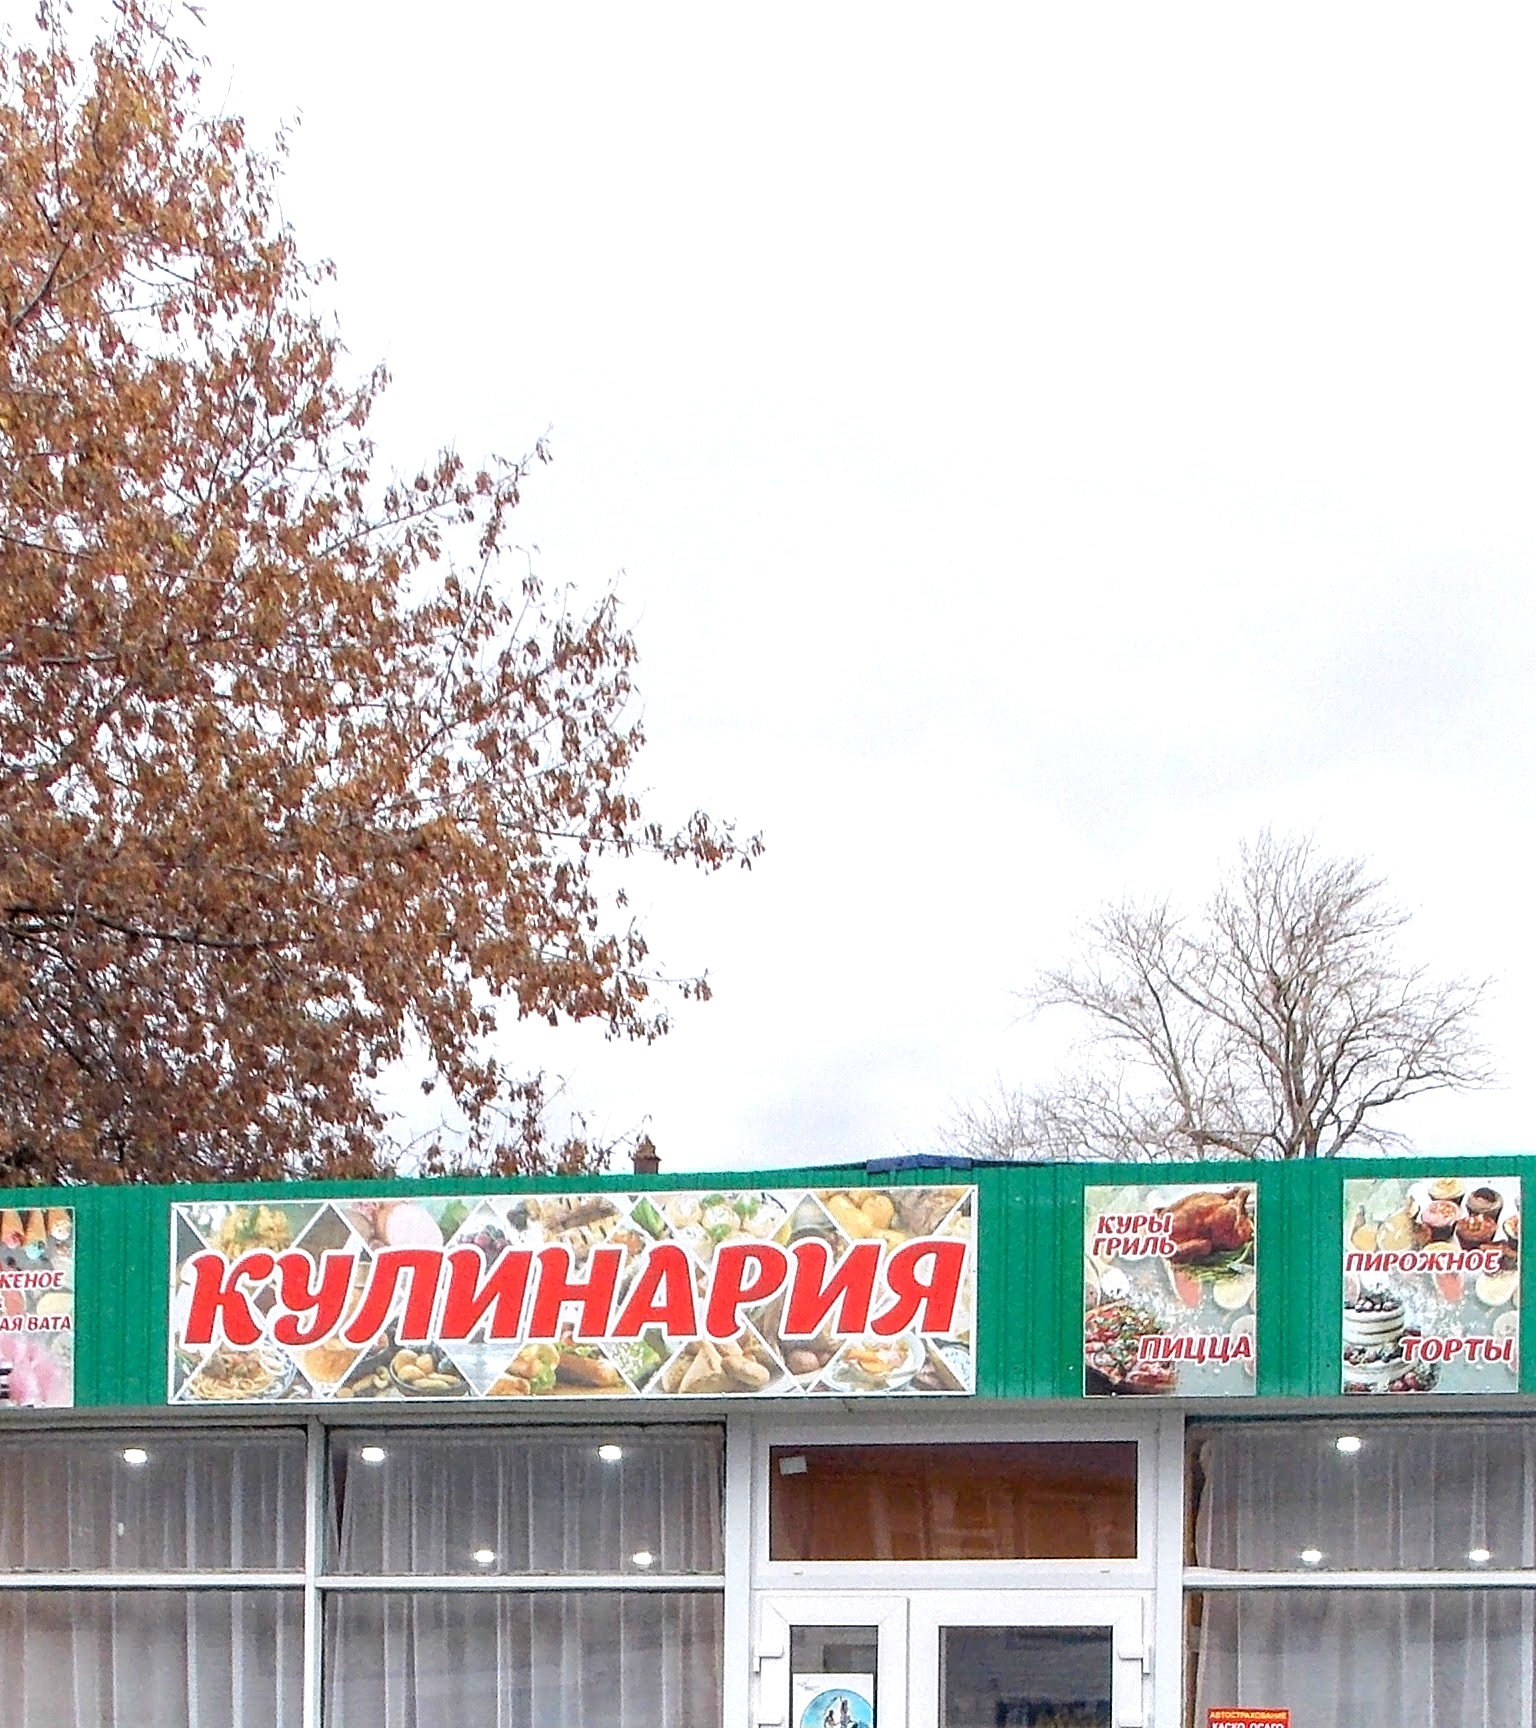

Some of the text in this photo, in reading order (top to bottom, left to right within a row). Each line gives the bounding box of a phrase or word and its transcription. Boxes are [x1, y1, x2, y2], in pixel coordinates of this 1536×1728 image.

[1097, 1214, 1174, 1234] КУРЫ
[1093, 1236, 1175, 1256] ГРИЛЬ
[1345, 1252, 1500, 1272] ПИРОЖНОЕ
[183, 1240, 967, 1344] КУЛИНАРИЯ
[28, 1316, 71, 1330] ВАТА
[1140, 1336, 1251, 1362] ПИЦЦА
[1401, 1338, 1512, 1361] ТОРТЫ
